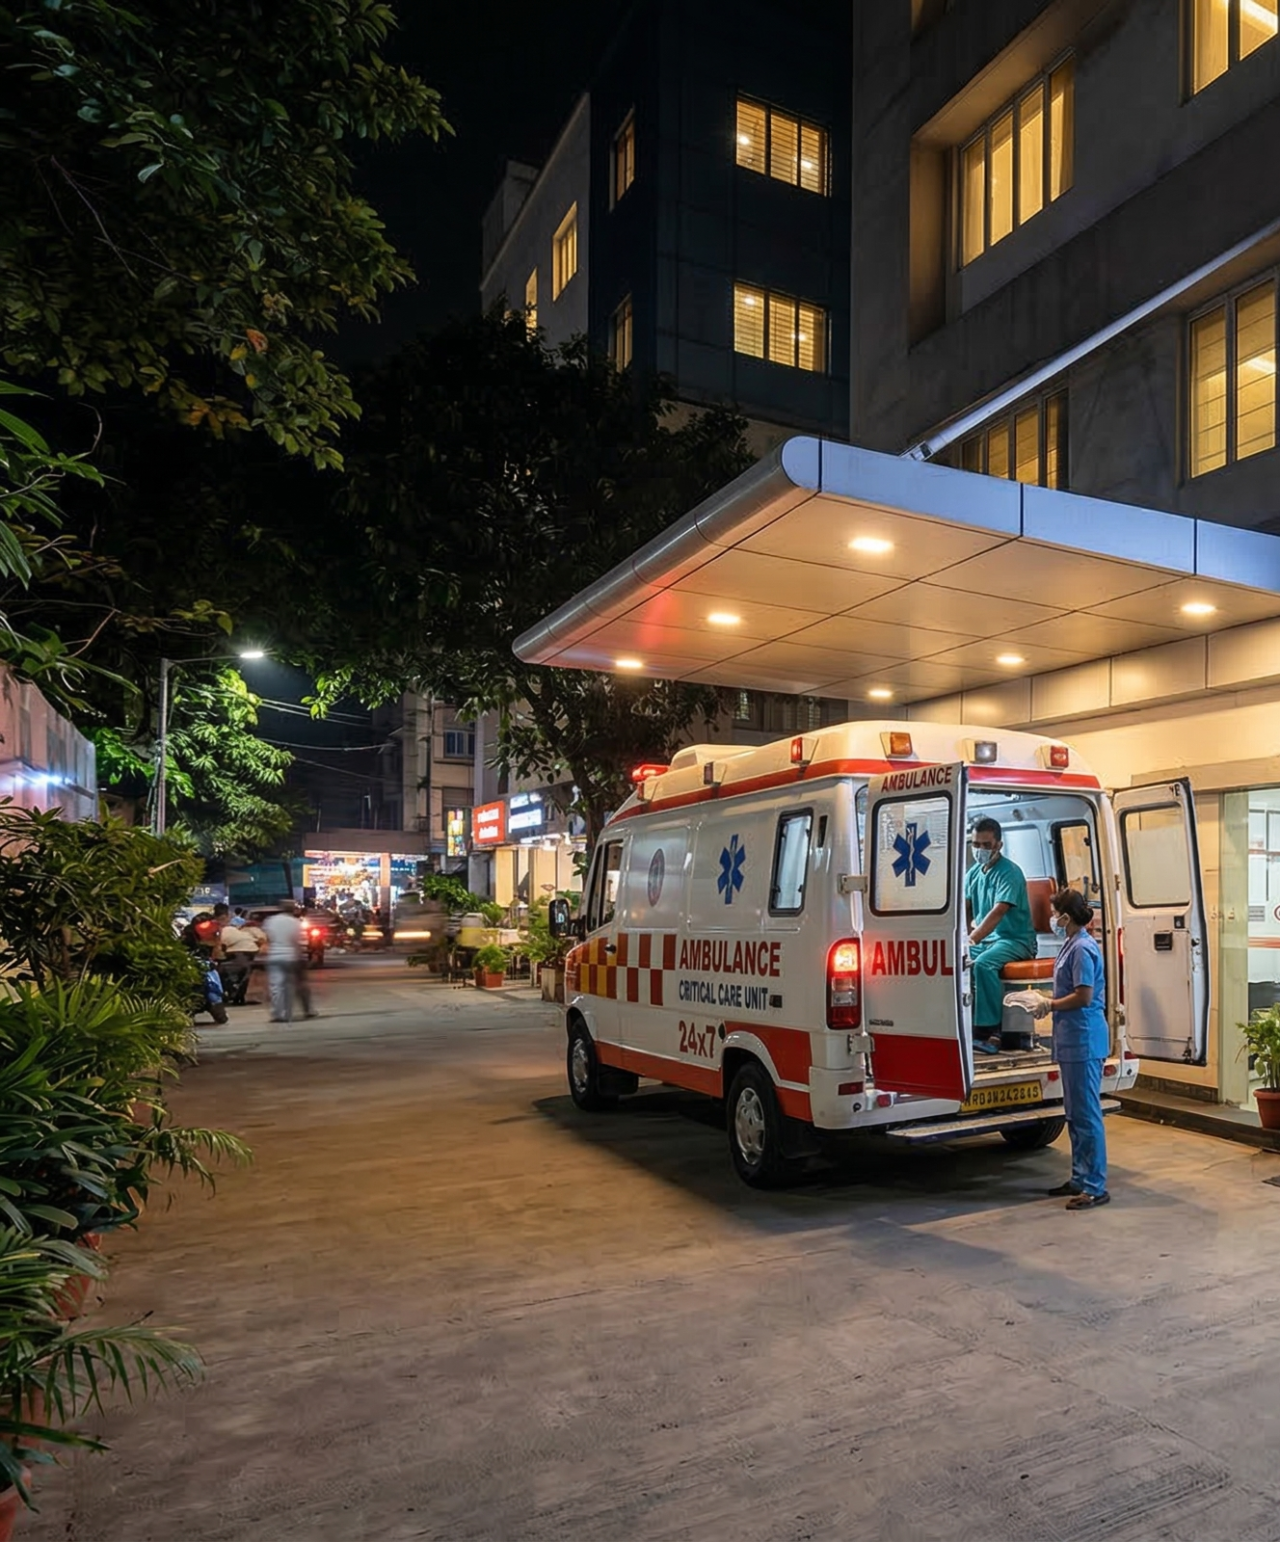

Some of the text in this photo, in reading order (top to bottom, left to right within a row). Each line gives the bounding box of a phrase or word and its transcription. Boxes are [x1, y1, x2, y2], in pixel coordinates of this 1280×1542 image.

[881, 767, 952, 793] AMBULANCE
[679, 939, 781, 977] AMBULANCE
[871, 939, 954, 977] AMBUL
[678, 979, 768, 1011] CRITICAL CARE UNIT
[678, 1020, 716, 1059] 24x7
